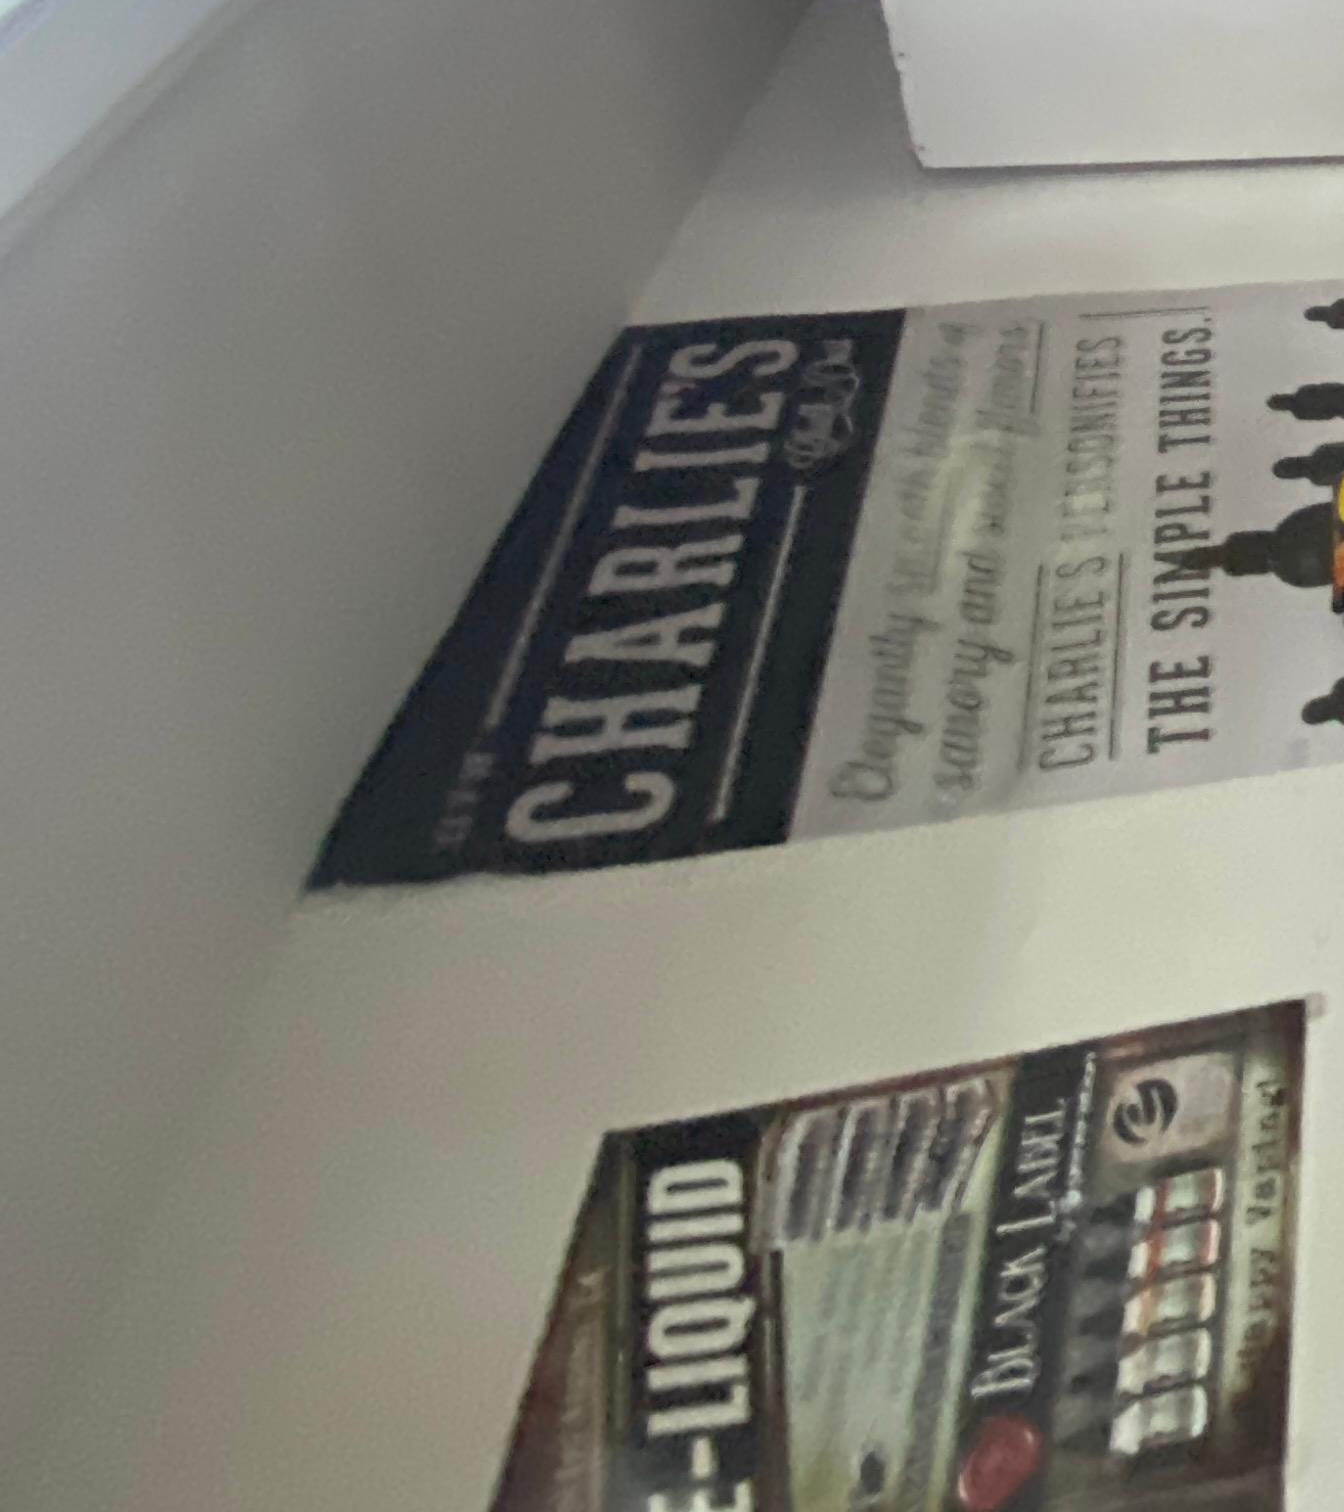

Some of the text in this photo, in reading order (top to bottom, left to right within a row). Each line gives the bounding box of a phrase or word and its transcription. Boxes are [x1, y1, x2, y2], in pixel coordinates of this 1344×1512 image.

[506, 339, 798, 842] CHARLIE'S
[953, 551, 1002, 625] and
[1037, 335, 1123, 770] CHARLIE'S PERSONIFIES
[1147, 315, 1213, 753] THE SIMPLE THINGS.
[829, 615, 938, 801] Elegantly
[934, 637, 1014, 791] savory
[970, 1097, 1070, 1397] BLACK LABEL
